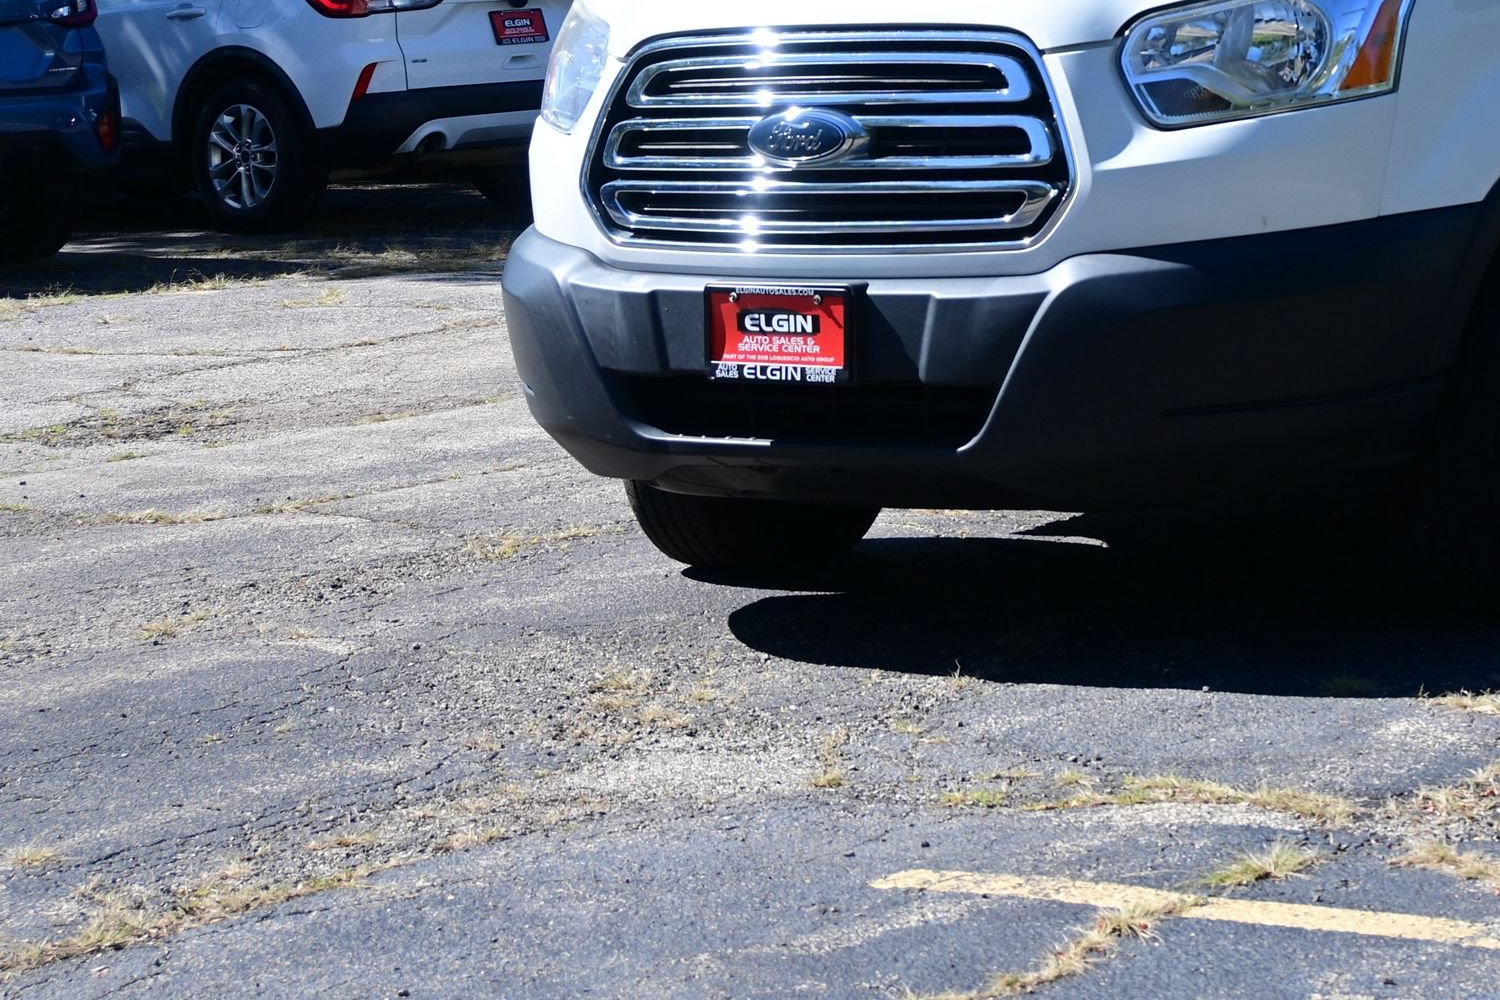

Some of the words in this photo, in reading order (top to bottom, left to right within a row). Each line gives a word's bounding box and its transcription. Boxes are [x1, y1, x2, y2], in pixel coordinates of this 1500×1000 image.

[505, 19, 530, 27] ELGIN
[768, 120, 824, 152] Ford
[735, 287, 814, 296] ELGINAUTOSALES.COM
[744, 313, 813, 334] ELGIN
[743, 336, 770, 344] AUTO
[772, 336, 804, 346] SALES
[738, 343, 779, 352] SERVICE
[782, 344, 821, 353] CENTER
[718, 363, 738, 371] AUTO
[805, 367, 837, 376] SERVICE
[715, 370, 739, 379] SALES
[743, 364, 802, 381] ELGIN
[806, 375, 836, 384] CENTER
